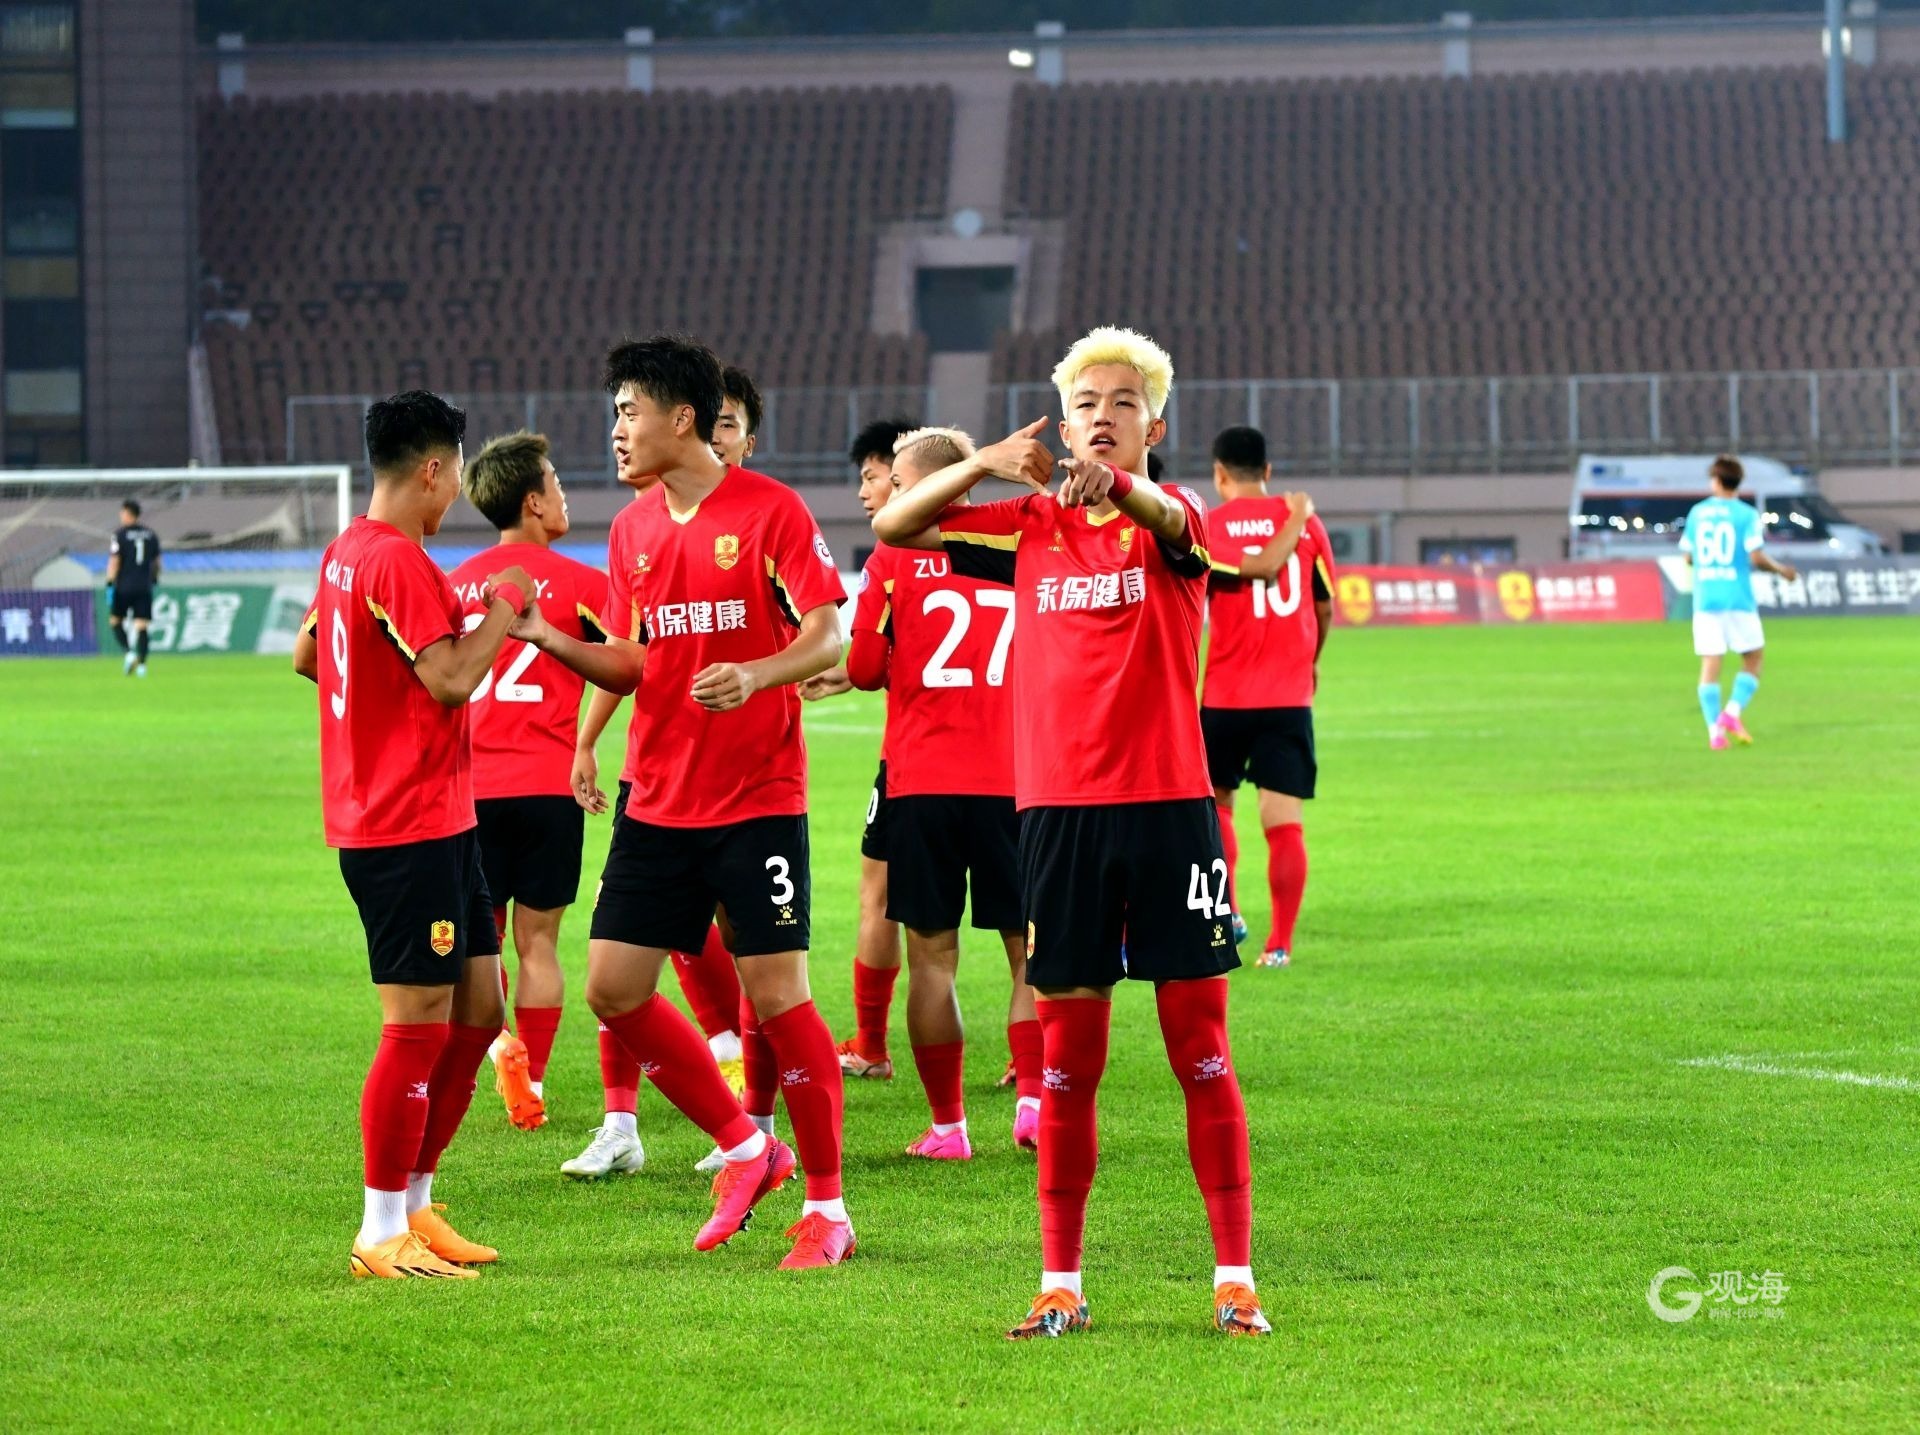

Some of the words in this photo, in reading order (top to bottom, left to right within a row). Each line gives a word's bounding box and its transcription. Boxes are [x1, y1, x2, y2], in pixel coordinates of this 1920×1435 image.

[1225, 518, 1275, 537] WANG
[133, 538, 145, 566] 1
[913, 557, 948, 578] ZU
[1036, 566, 1147, 614] 永保健康
[921, 588, 1016, 689] 27
[331, 607, 348, 720] 9
[765, 855, 795, 906] 3
[1186, 857, 1232, 920] 42
[775, 918, 798, 926] KELME
[1042, 1079, 1071, 1092] ELME
